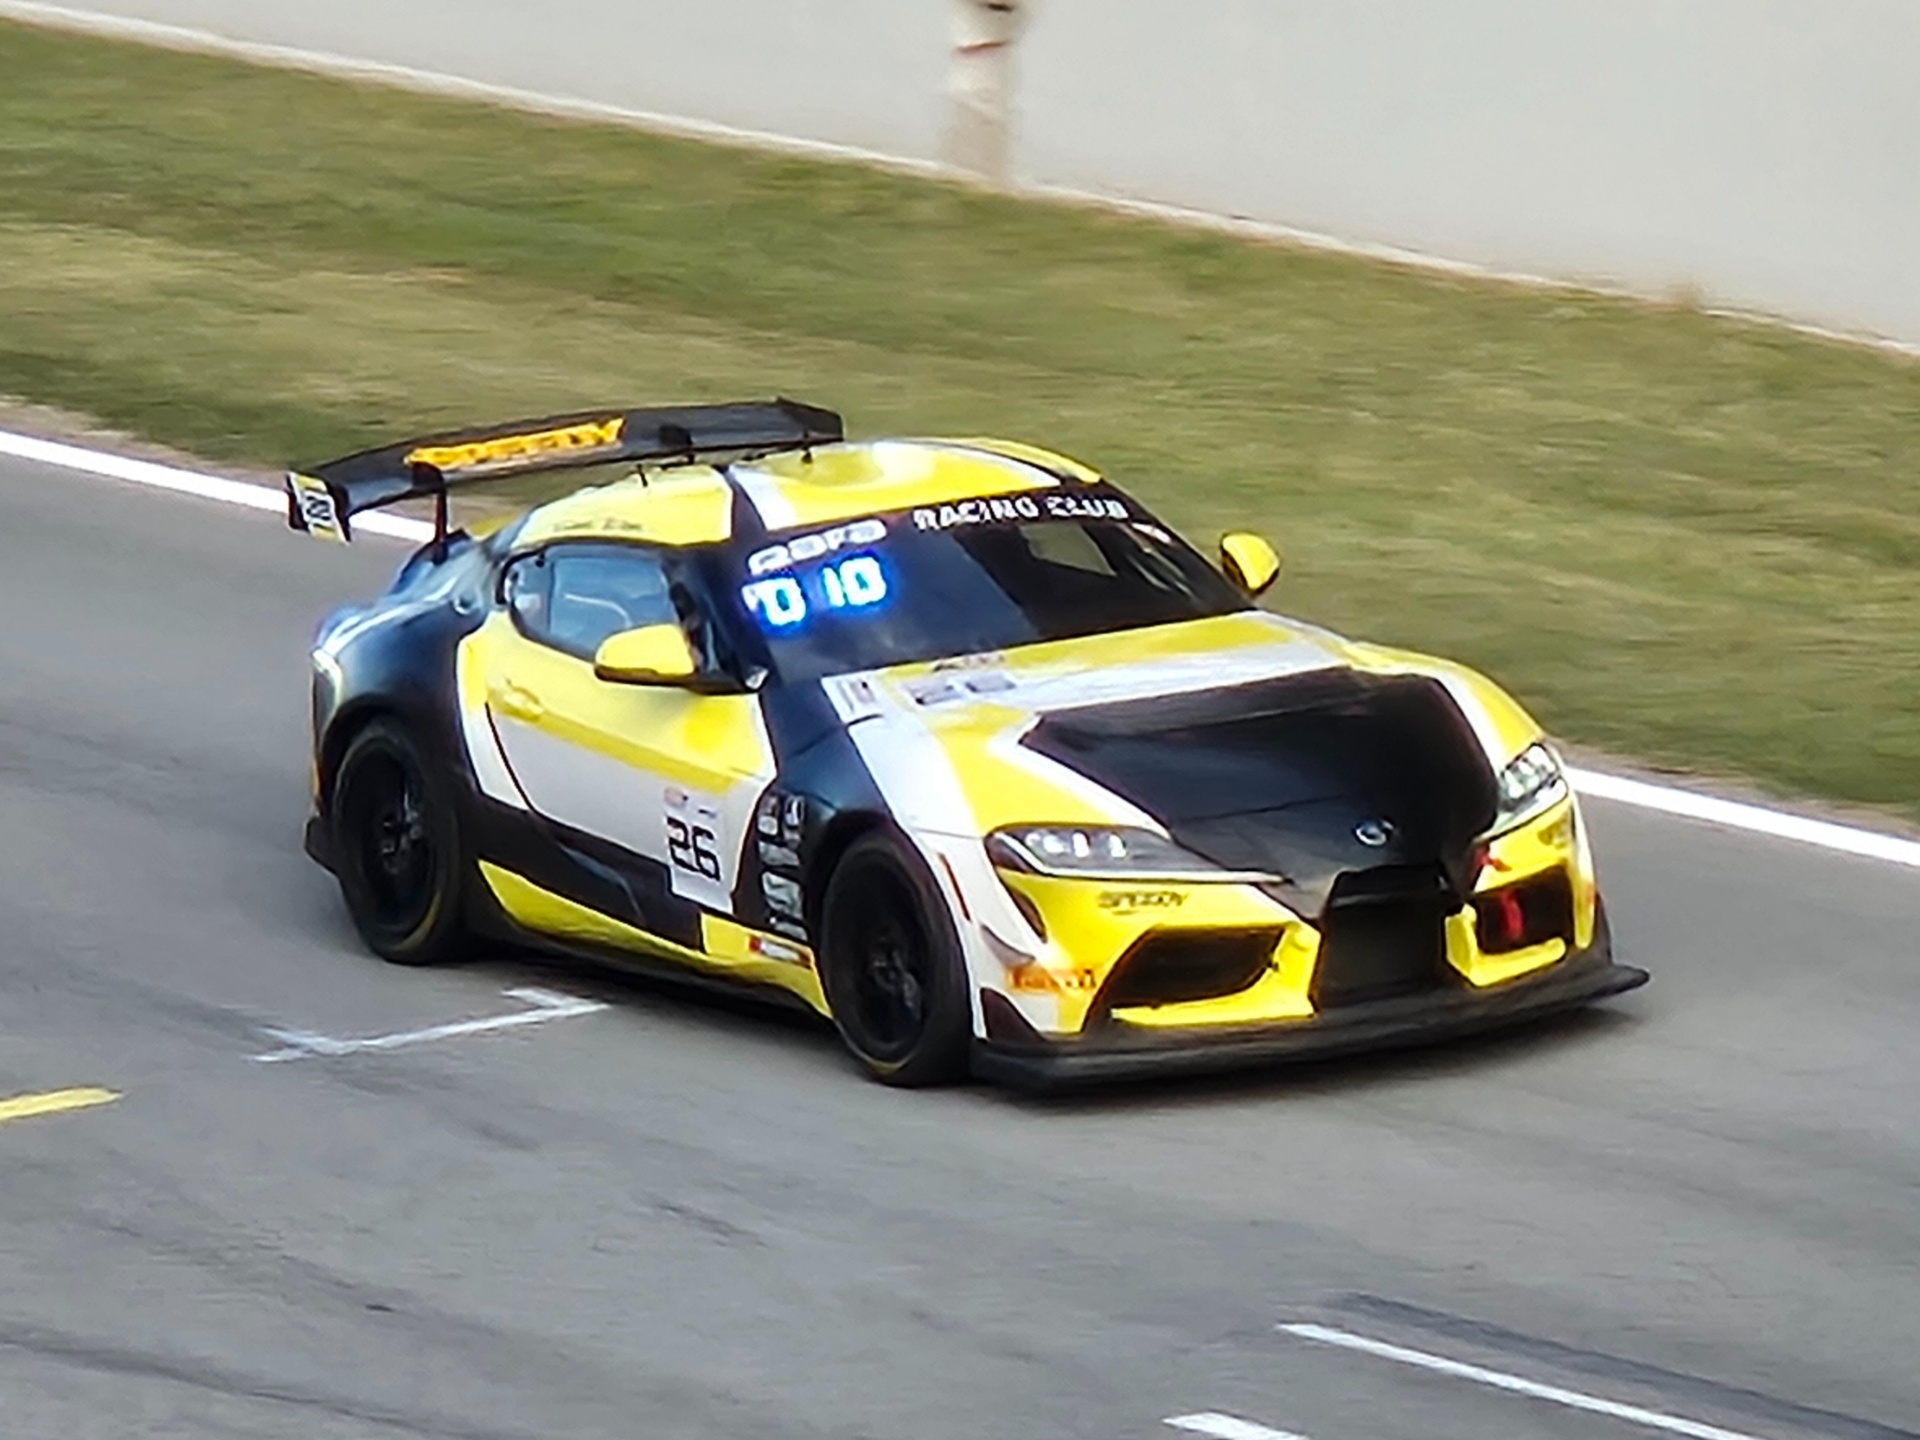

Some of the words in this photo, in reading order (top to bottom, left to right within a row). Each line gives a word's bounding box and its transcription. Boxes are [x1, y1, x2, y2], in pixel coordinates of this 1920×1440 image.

[913, 496, 1039, 530] RACING
[1046, 496, 1129, 519] CLUB
[667, 817, 721, 882] 26
